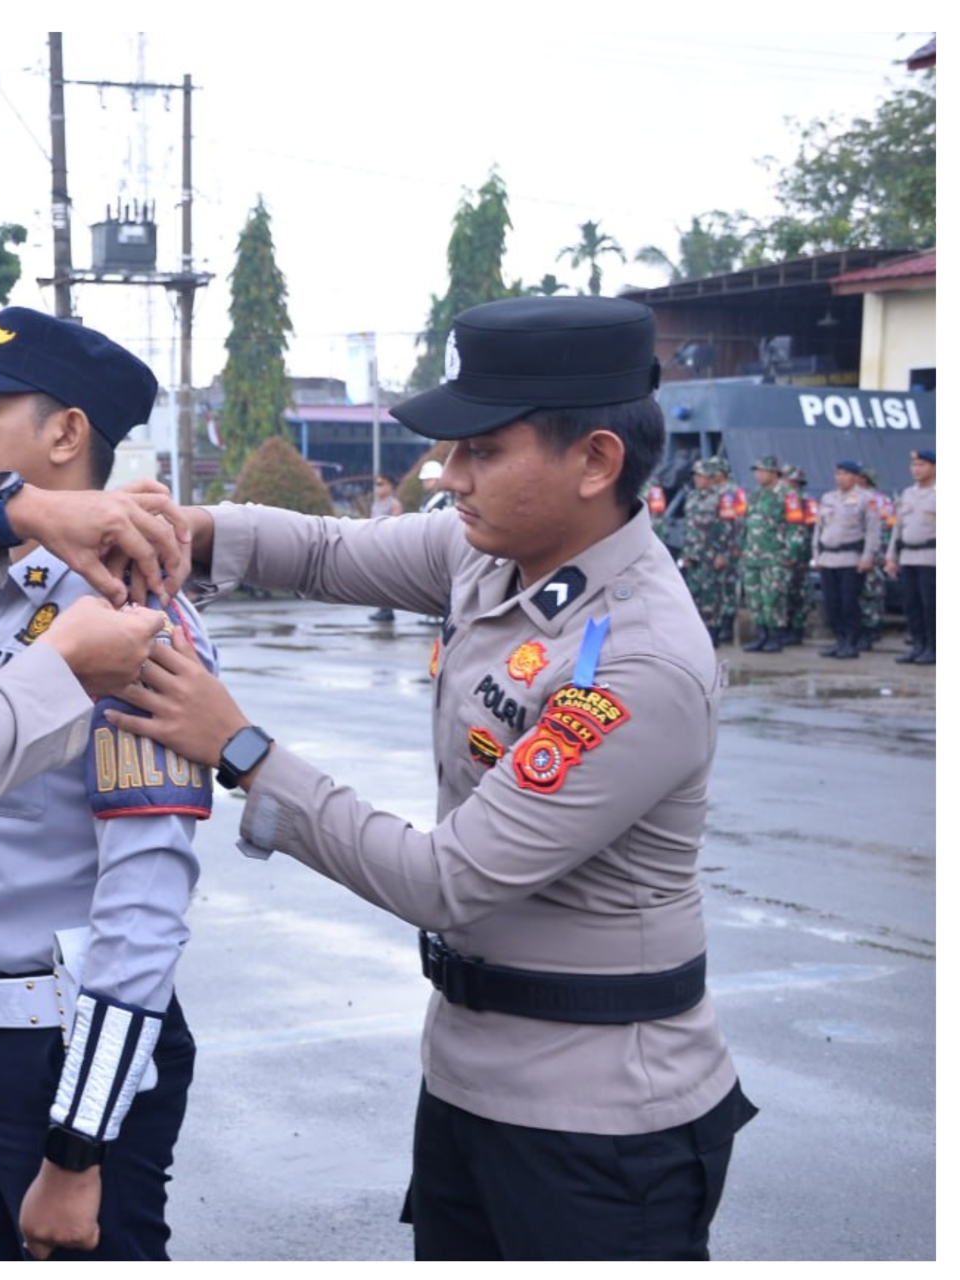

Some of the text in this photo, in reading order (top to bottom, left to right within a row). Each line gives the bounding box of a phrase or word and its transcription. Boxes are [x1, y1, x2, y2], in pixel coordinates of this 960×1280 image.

[799, 395, 921, 429] POLISI
[473, 673, 526, 732] POLRI
[554, 688, 621, 720] POLRES
[557, 699, 607, 723] LANGSA
[552, 712, 593, 740] ACEH
